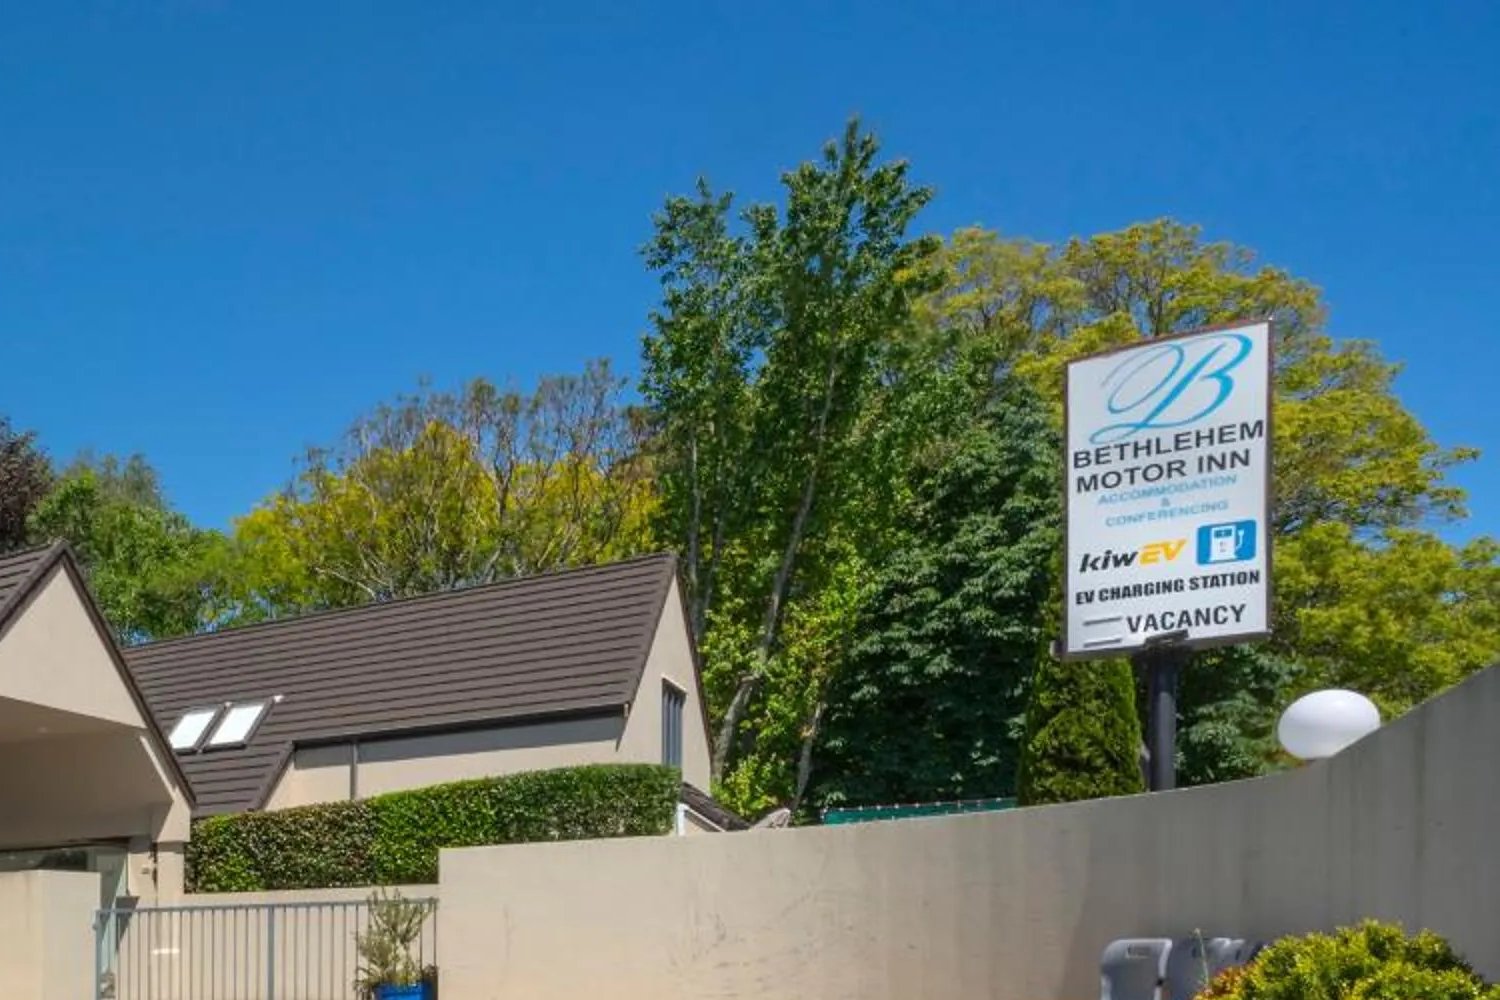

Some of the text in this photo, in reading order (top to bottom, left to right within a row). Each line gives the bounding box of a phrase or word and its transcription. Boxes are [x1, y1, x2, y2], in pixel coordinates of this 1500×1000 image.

[1073, 420, 1265, 469] BETHLEHEM
[1076, 449, 1250, 494] MOTOR INN
[1098, 474, 1238, 505] ACCOMMODATION
[1105, 499, 1230, 528] CONFERENCING
[1075, 570, 1261, 605] EV CHARGING STATION
[1126, 604, 1247, 634] VACANCY
